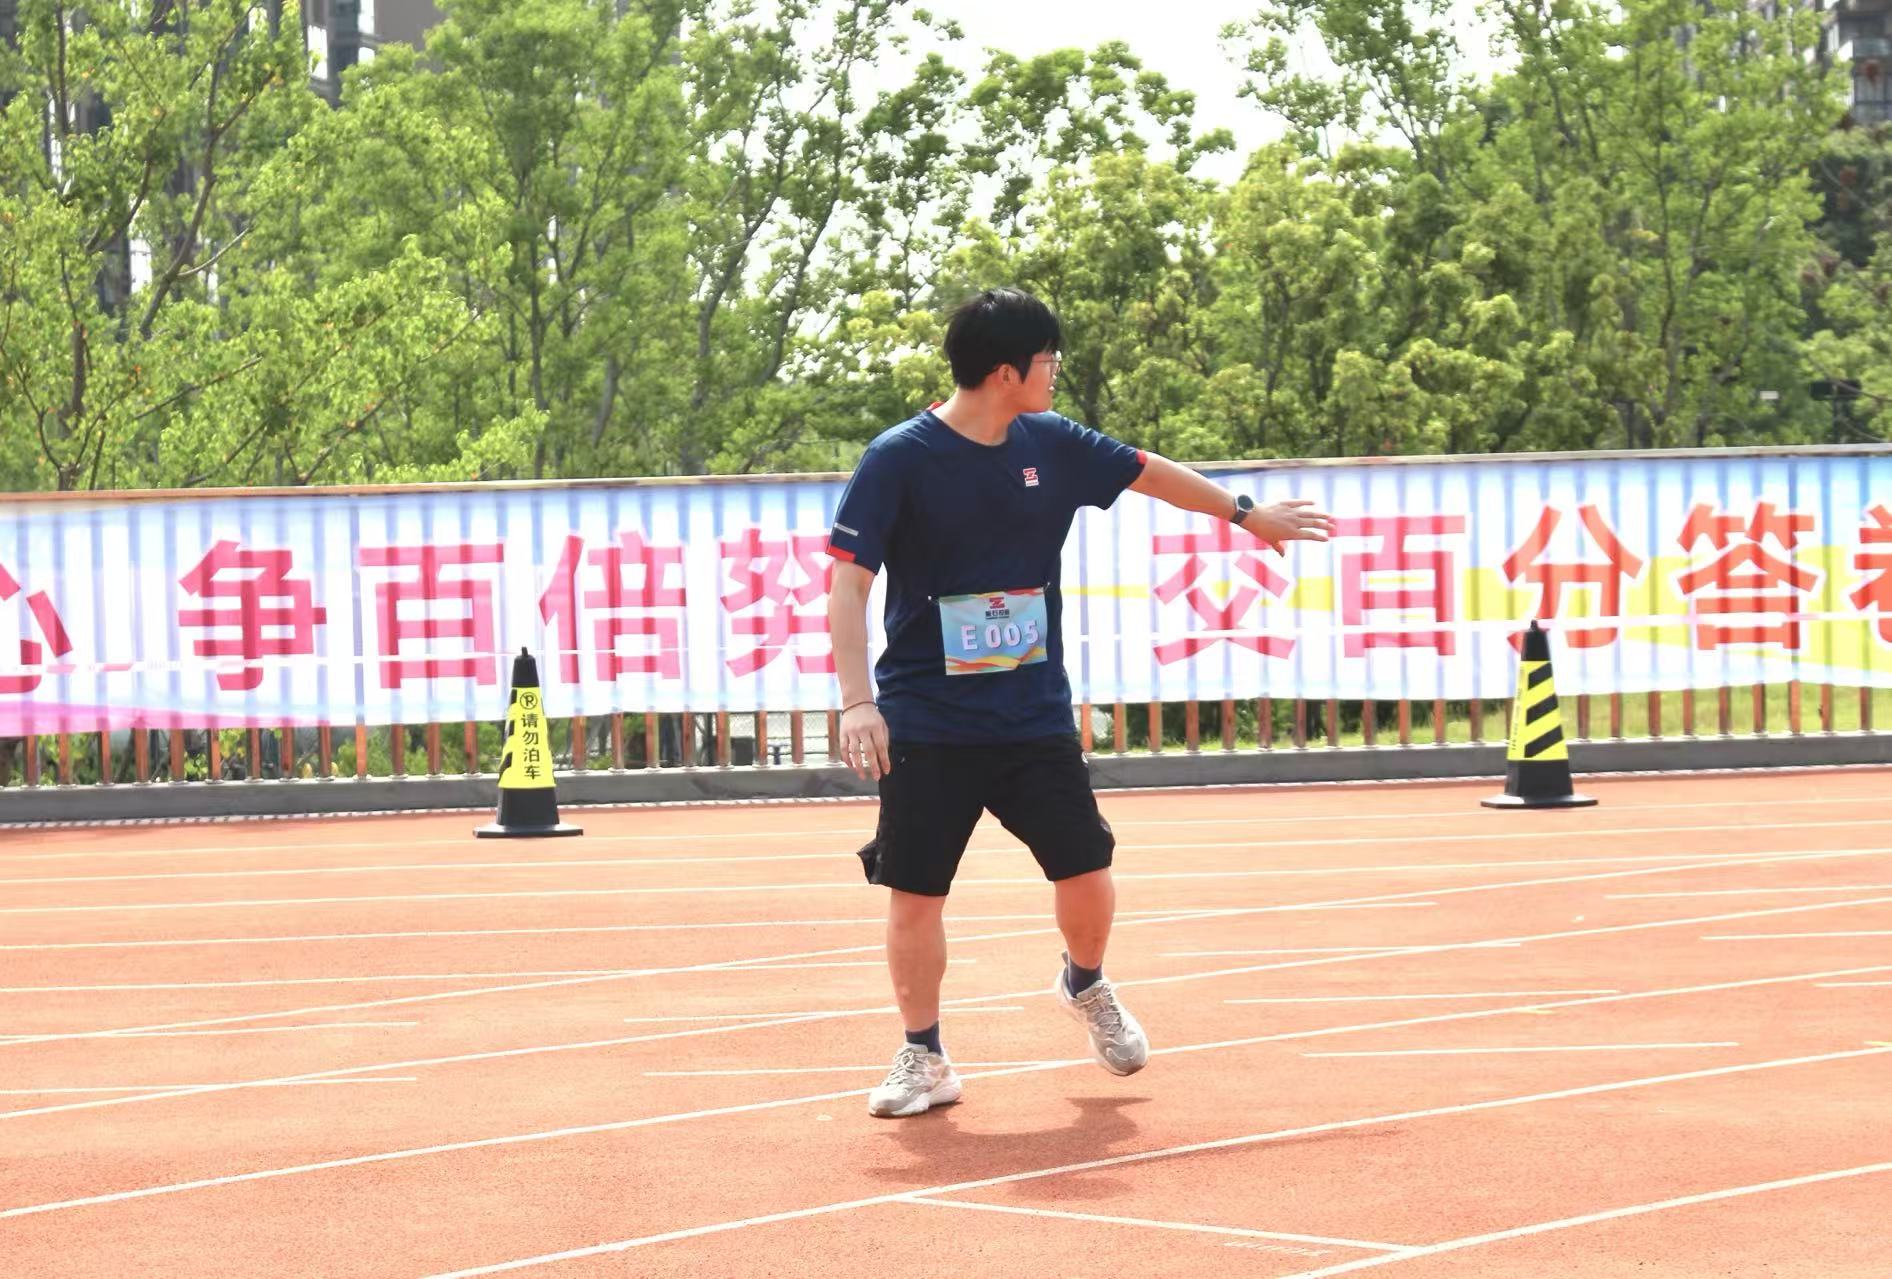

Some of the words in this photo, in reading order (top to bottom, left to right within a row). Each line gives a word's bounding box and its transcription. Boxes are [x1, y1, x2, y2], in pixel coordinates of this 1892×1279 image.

[960, 624, 978, 651] E
[985, 619, 1039, 648] 005
[521, 713, 541, 780] 请勿泊车
